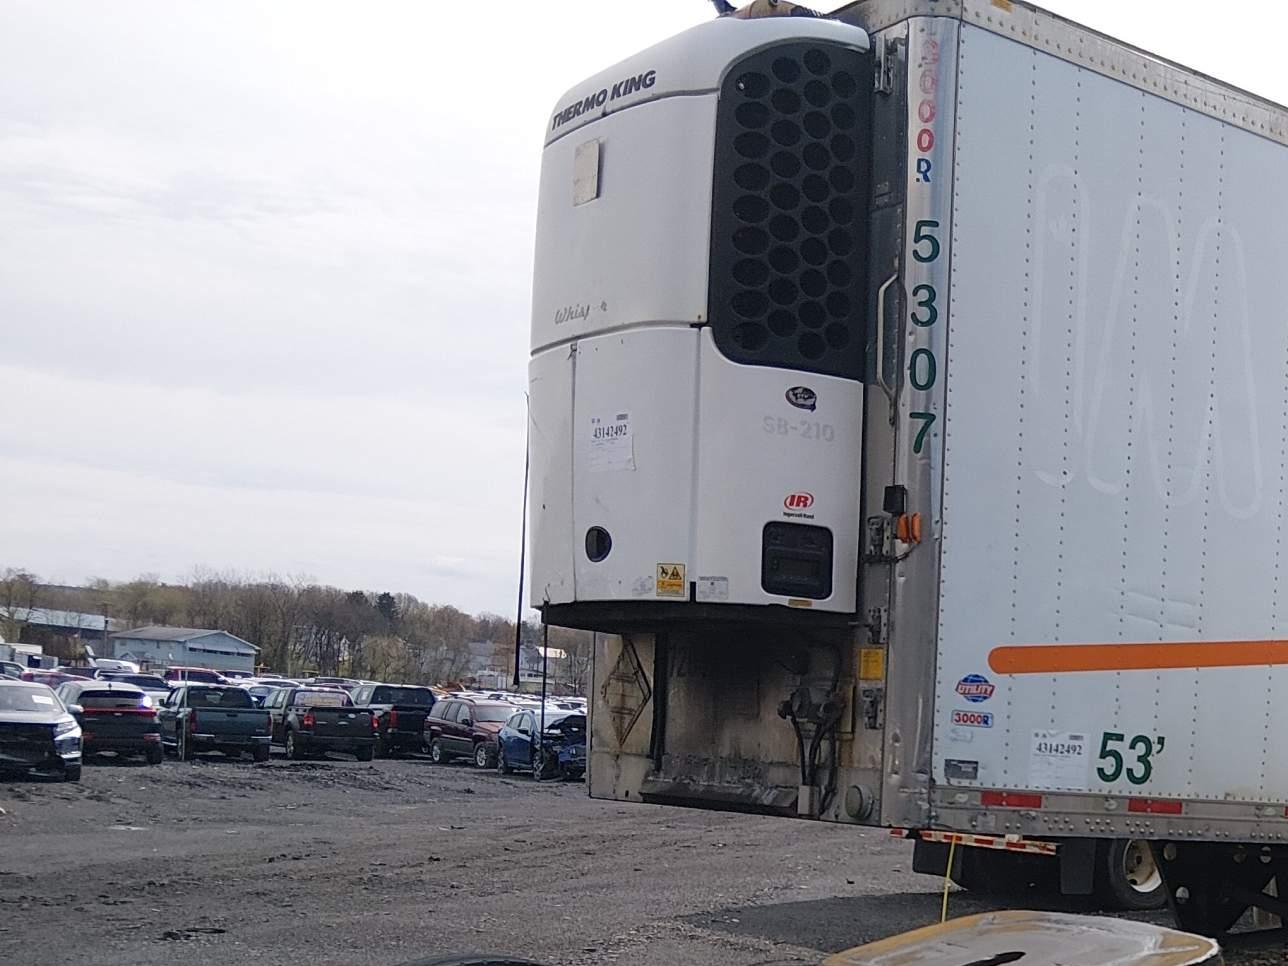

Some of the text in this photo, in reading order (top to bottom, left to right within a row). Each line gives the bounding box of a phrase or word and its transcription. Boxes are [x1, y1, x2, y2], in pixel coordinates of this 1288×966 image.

[552, 70, 656, 131] THERMO KING
[789, 494, 810, 508] IR
[954, 712, 990, 726] 3000R
[1036, 742, 1083, 756] 43142492
